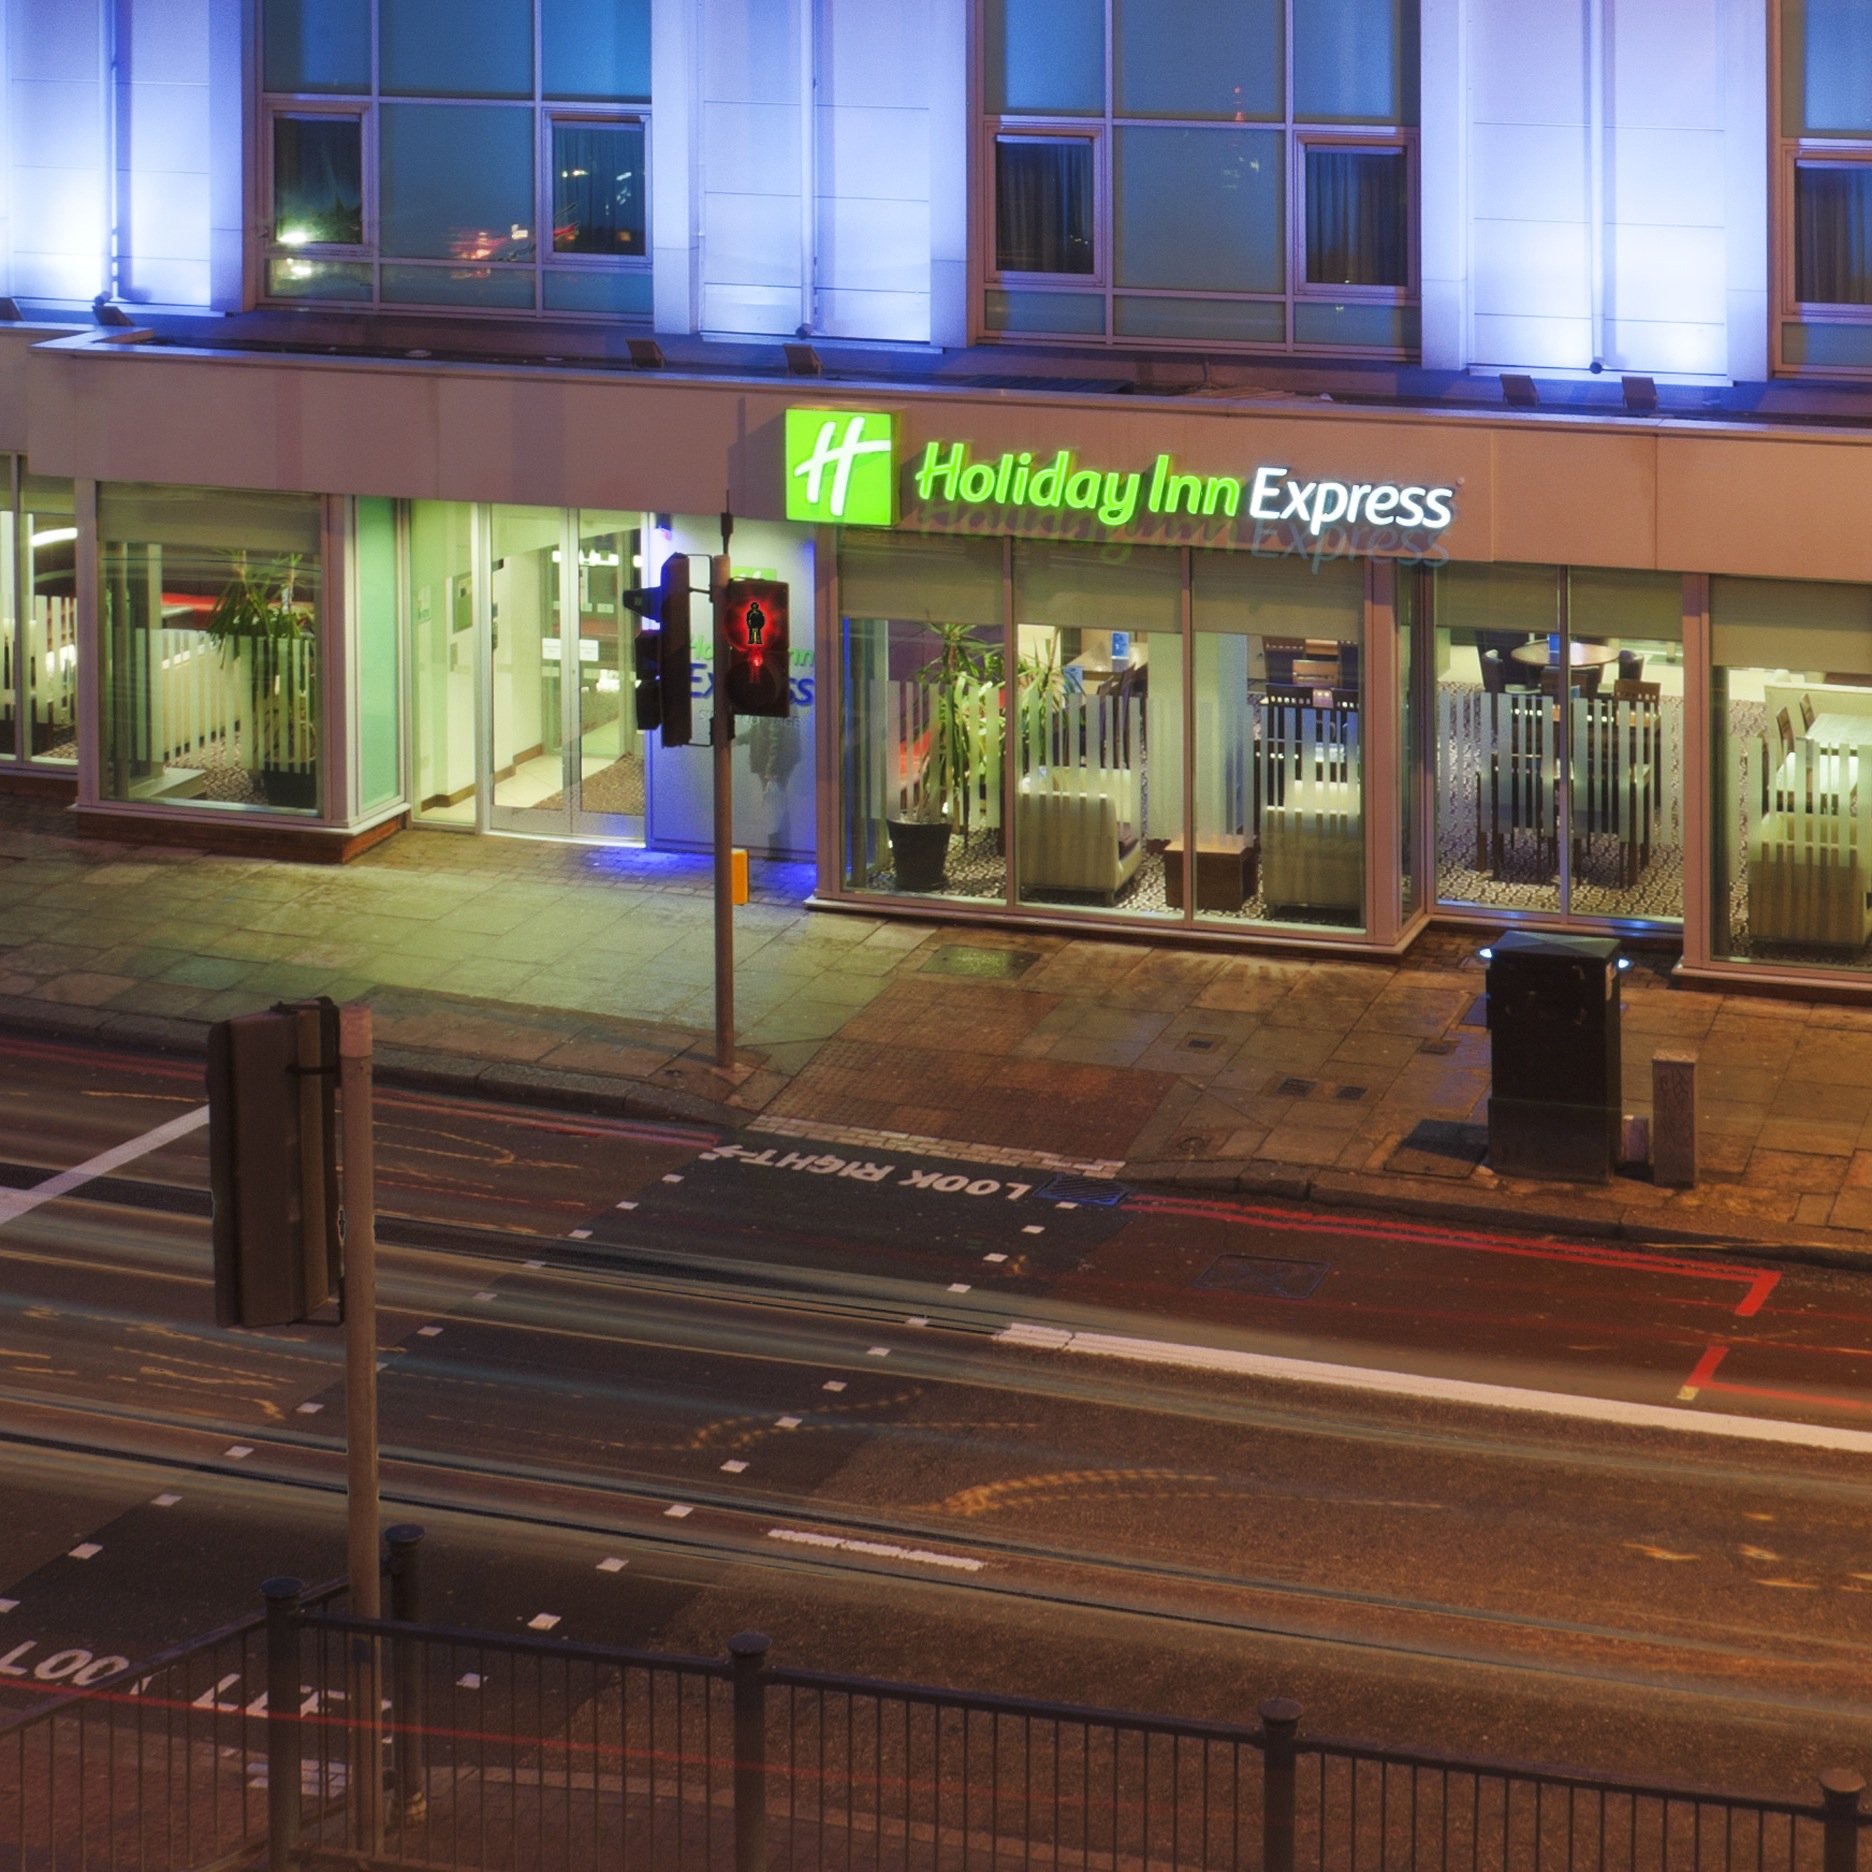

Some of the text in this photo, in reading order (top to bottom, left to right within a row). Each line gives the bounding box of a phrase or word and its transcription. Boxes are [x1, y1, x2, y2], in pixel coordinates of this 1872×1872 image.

[914, 440, 1454, 536] Holiday Inn Express
[740, 1148, 1032, 1201] LOOK RIGHT
